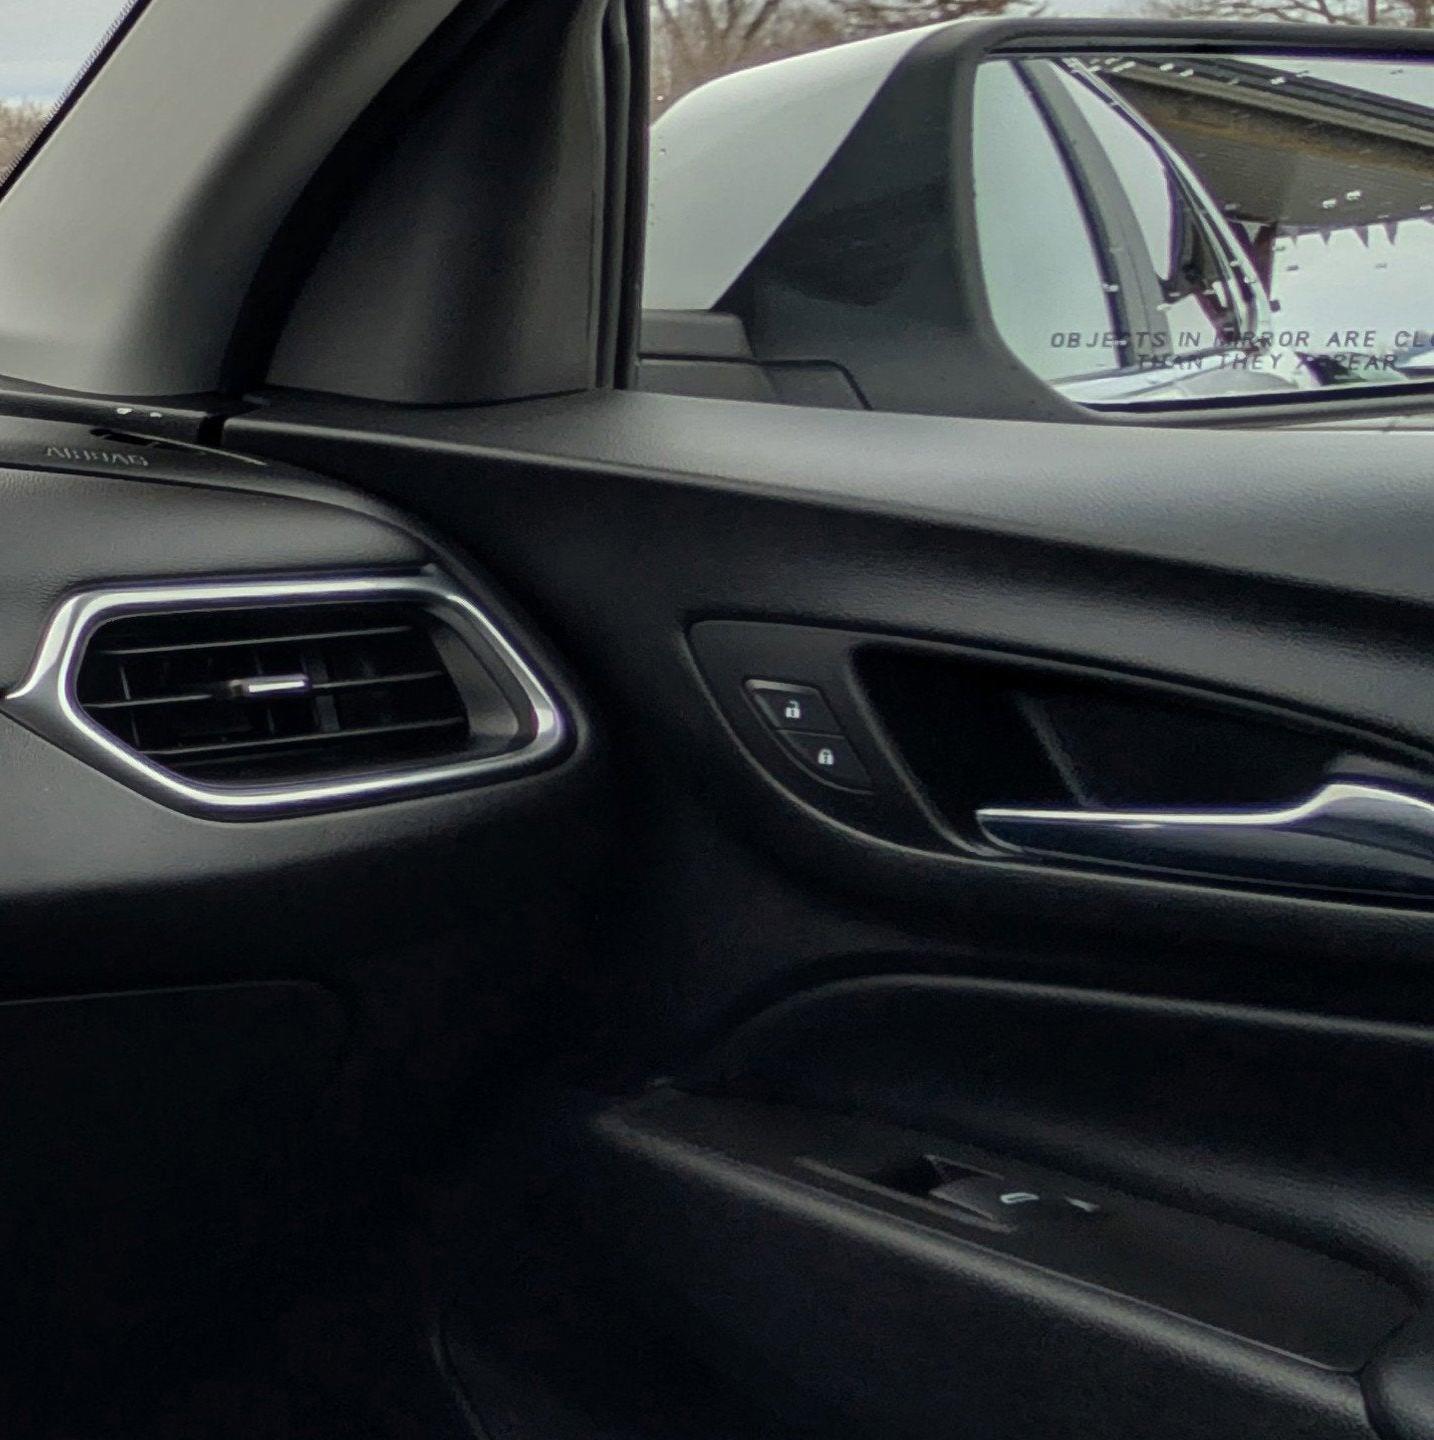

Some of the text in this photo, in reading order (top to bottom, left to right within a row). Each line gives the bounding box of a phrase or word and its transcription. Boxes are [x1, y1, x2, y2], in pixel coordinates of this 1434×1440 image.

[1050, 330, 1167, 349] OBJECTS
[1179, 331, 1201, 348] IN
[1214, 330, 1310, 348] MIRROR
[1328, 331, 1377, 348] ARE
[1138, 354, 1398, 372] THAN THEY APPEAR
